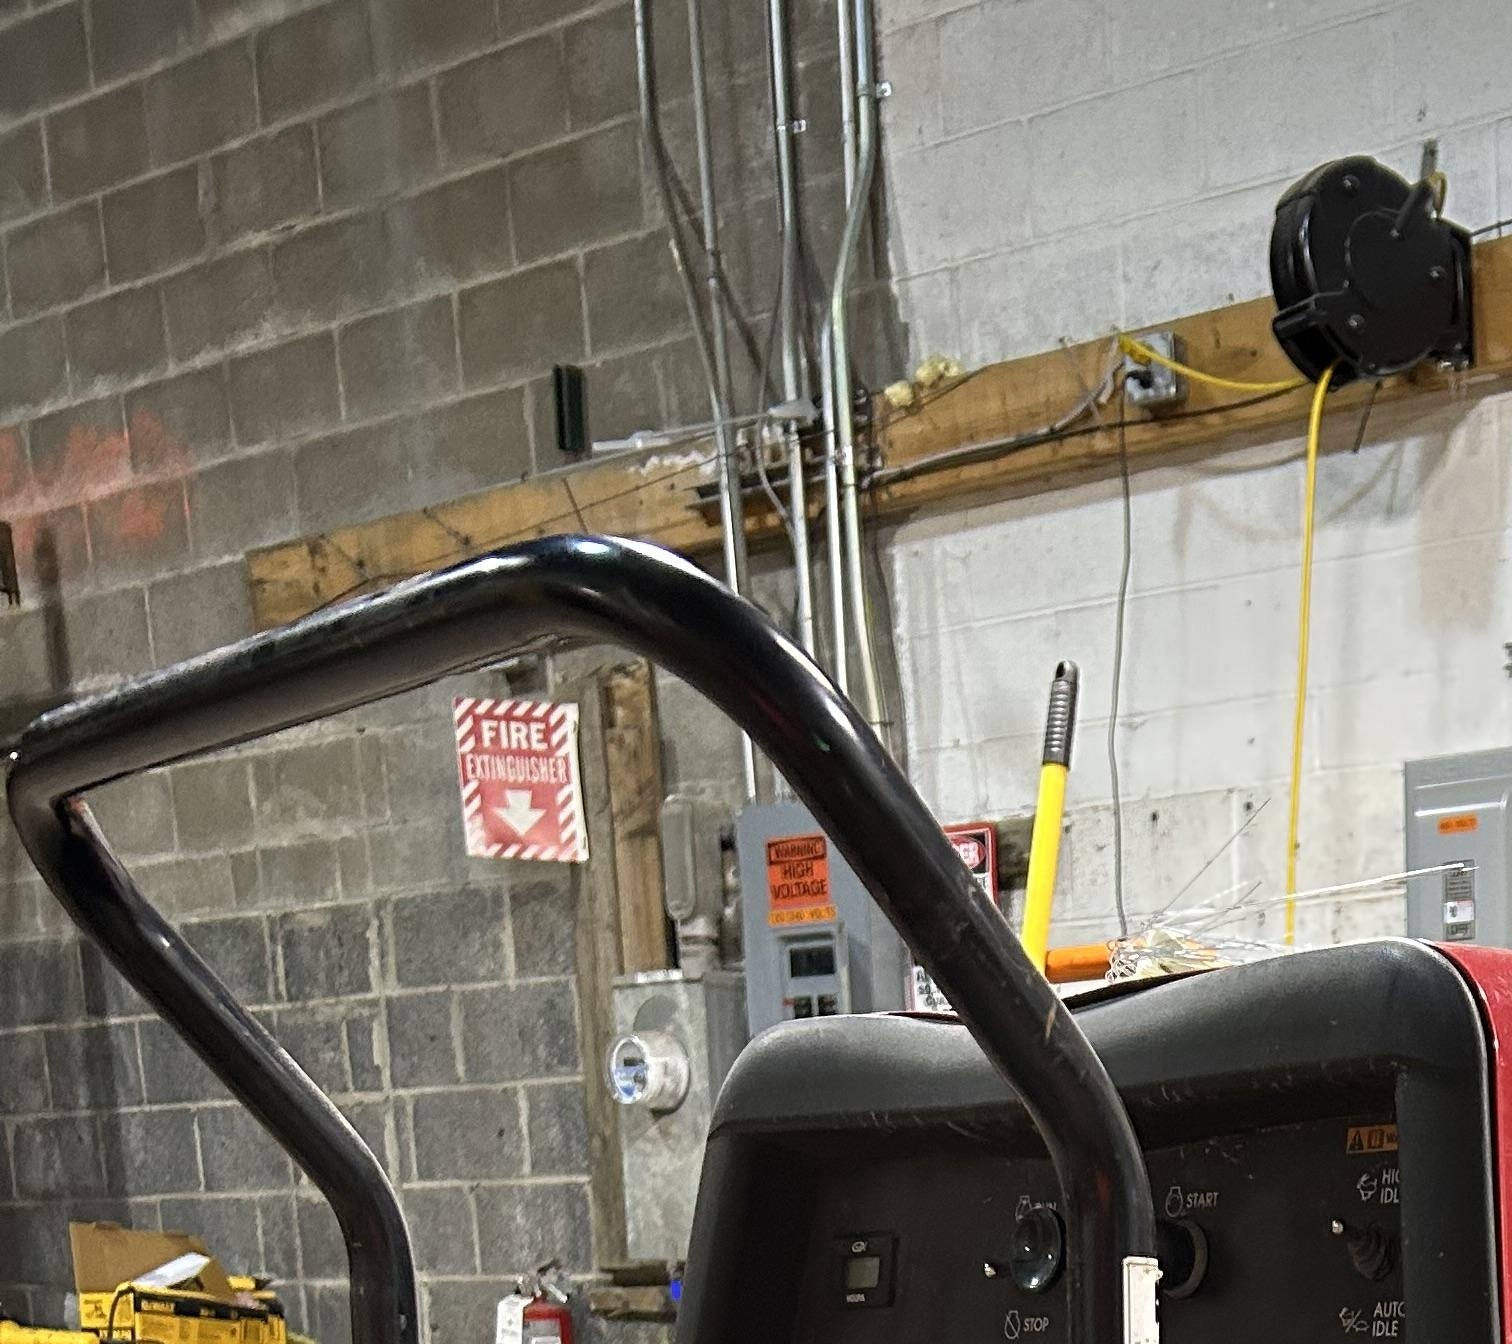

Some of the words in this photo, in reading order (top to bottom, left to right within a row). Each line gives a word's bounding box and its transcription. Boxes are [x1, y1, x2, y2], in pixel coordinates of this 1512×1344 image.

[481, 719, 549, 751] FIRE
[466, 753, 568, 784] EXTINGUISHER
[782, 862, 814, 880] HIGH
[771, 879, 828, 899] VOLTAGE
[1186, 1192, 1219, 1208] START
[1023, 1317, 1049, 1332] STOP
[1372, 1320, 1398, 1337] IDLE
